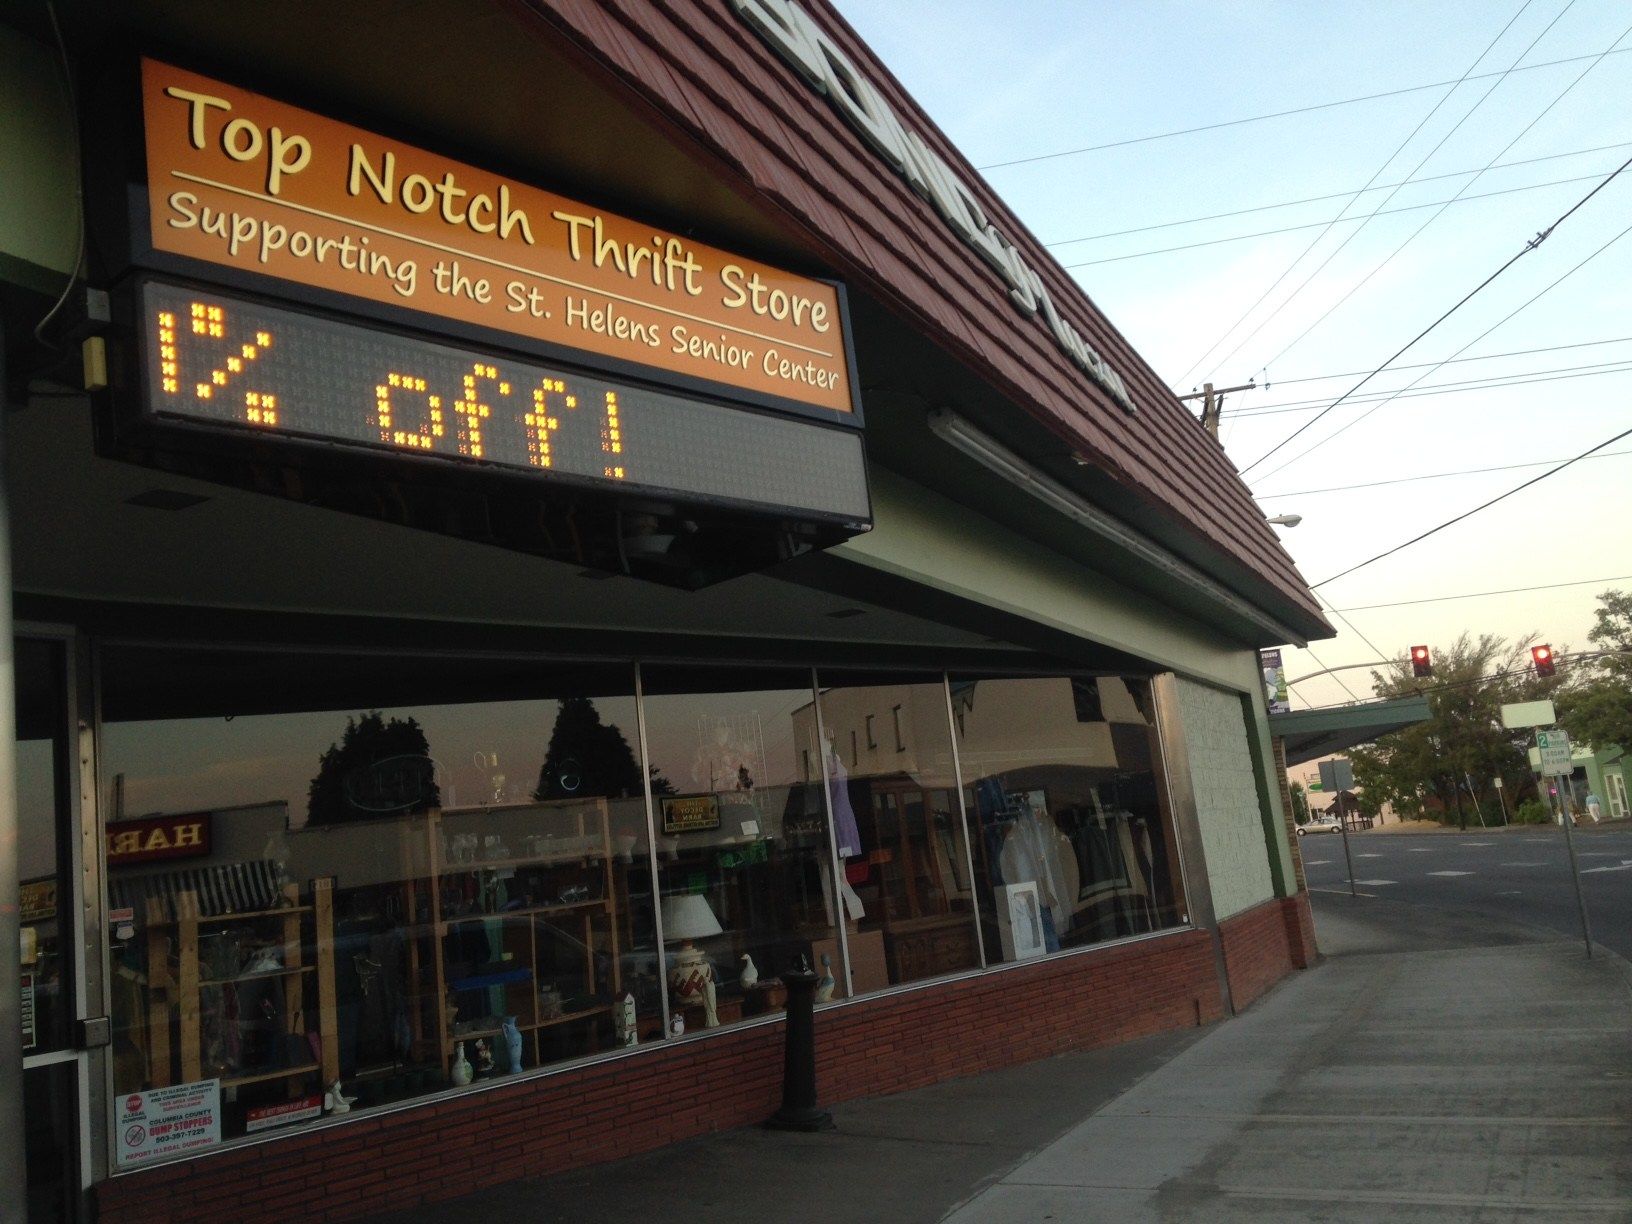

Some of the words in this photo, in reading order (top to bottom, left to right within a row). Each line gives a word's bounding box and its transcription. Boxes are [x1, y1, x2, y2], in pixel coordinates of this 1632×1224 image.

[166, 86, 312, 195] Top
[349, 143, 535, 245] Notch
[553, 210, 703, 296] Thrift
[720, 264, 830, 333] Store
[168, 191, 417, 297] Supporting
[432, 261, 491, 303] the
[506, 281, 551, 318] St.
[566, 296, 661, 347] Helens
[671, 325, 754, 369] Senior
[762, 349, 840, 391] Center
[1538, 735, 1547, 747] 2
[149, 1114, 183, 1126] COLUMBIA
[184, 1109, 212, 1119] COUNTY
[149, 1124, 173, 1137] DUMP
[174, 1116, 213, 1131] STOPPERS
[126, 1150, 152, 1160] REPORT
[153, 1145, 181, 1155] ILLEGAL
